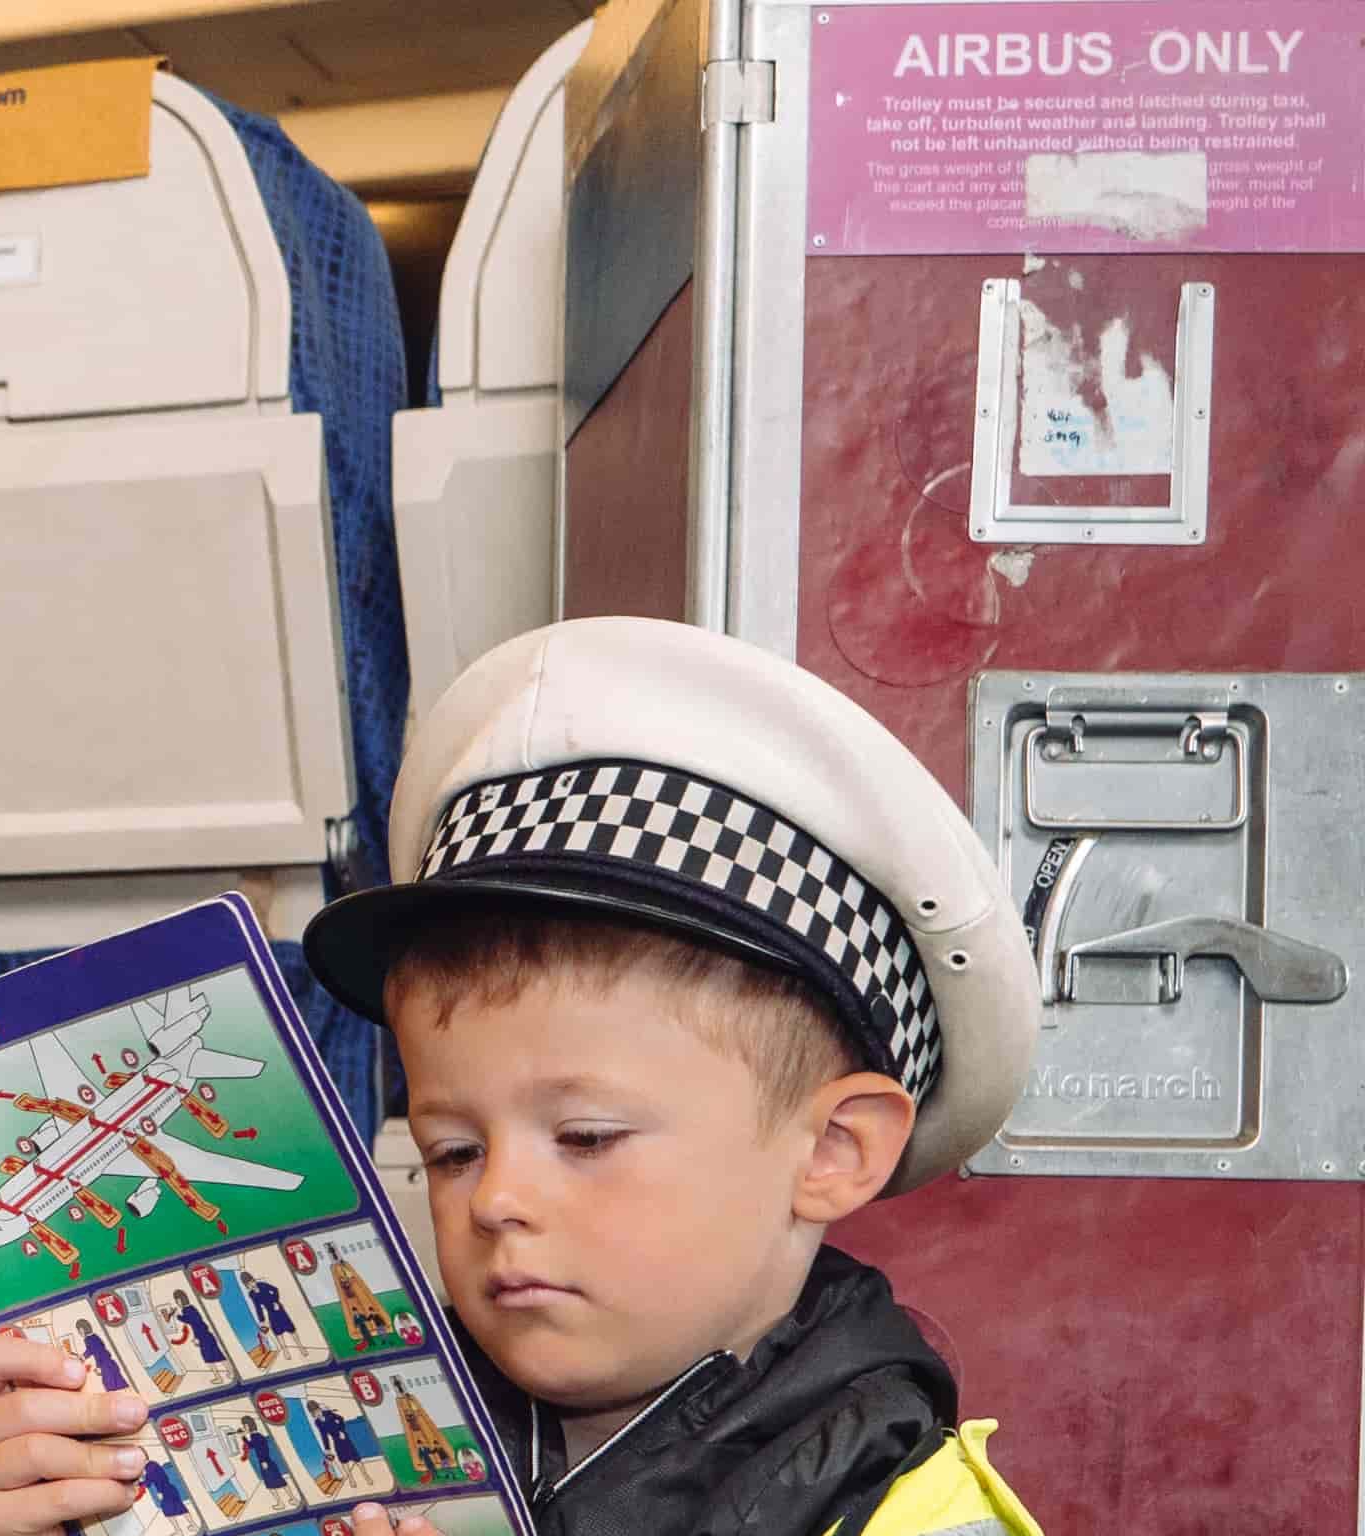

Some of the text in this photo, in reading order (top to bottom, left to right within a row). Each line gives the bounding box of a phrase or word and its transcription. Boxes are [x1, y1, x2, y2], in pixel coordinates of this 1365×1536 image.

[892, 30, 1304, 79] AIRBUS ONLY
[884, 96, 942, 114] Trolley
[949, 96, 991, 110] must
[997, 96, 1018, 110] be
[1025, 95, 1095, 110] secured
[1101, 94, 1134, 108] and
[1140, 94, 1204, 109] latched
[1210, 94, 1267, 111] during
[866, 116, 902, 132] take
[942, 115, 1022, 132] turbulent
[1028, 115, 1096, 130] weather
[1102, 114, 1136, 129] and
[1219, 113, 1278, 132] Trolley
[1285, 112, 1326, 129] shall
[891, 137, 919, 151] not
[925, 136, 946, 151] be
[952, 136, 979, 151] left
[985, 135, 1073, 150] unhanded
[1078, 134, 1144, 150] without
[1150, 133, 1198, 152] being
[867, 161, 895, 177] The
[899, 164, 940, 179] gross
[945, 160, 993, 178] weight
[998, 160, 1012, 175] of
[1254, 158, 1303, 176] weight
[1308, 157, 1324, 172] of
[937, 180, 964, 194] and
[969, 181, 996, 196] any
[1248, 177, 1286, 193] must
[1290, 176, 1314, 192] not
[889, 198, 944, 212] exceed
[949, 197, 972, 212] the
[1252, 195, 1268, 210] of
[1272, 195, 1297, 210] the
[1036, 840, 1069, 888] OPEN
[1022, 1064, 1222, 1102] Monarch
[294, 1251, 311, 1270] A
[201, 1276, 217, 1294] A
[105, 1303, 122, 1321] A
[358, 1382, 377, 1401] B
[324, 1521, 341, 1533] EXIT
